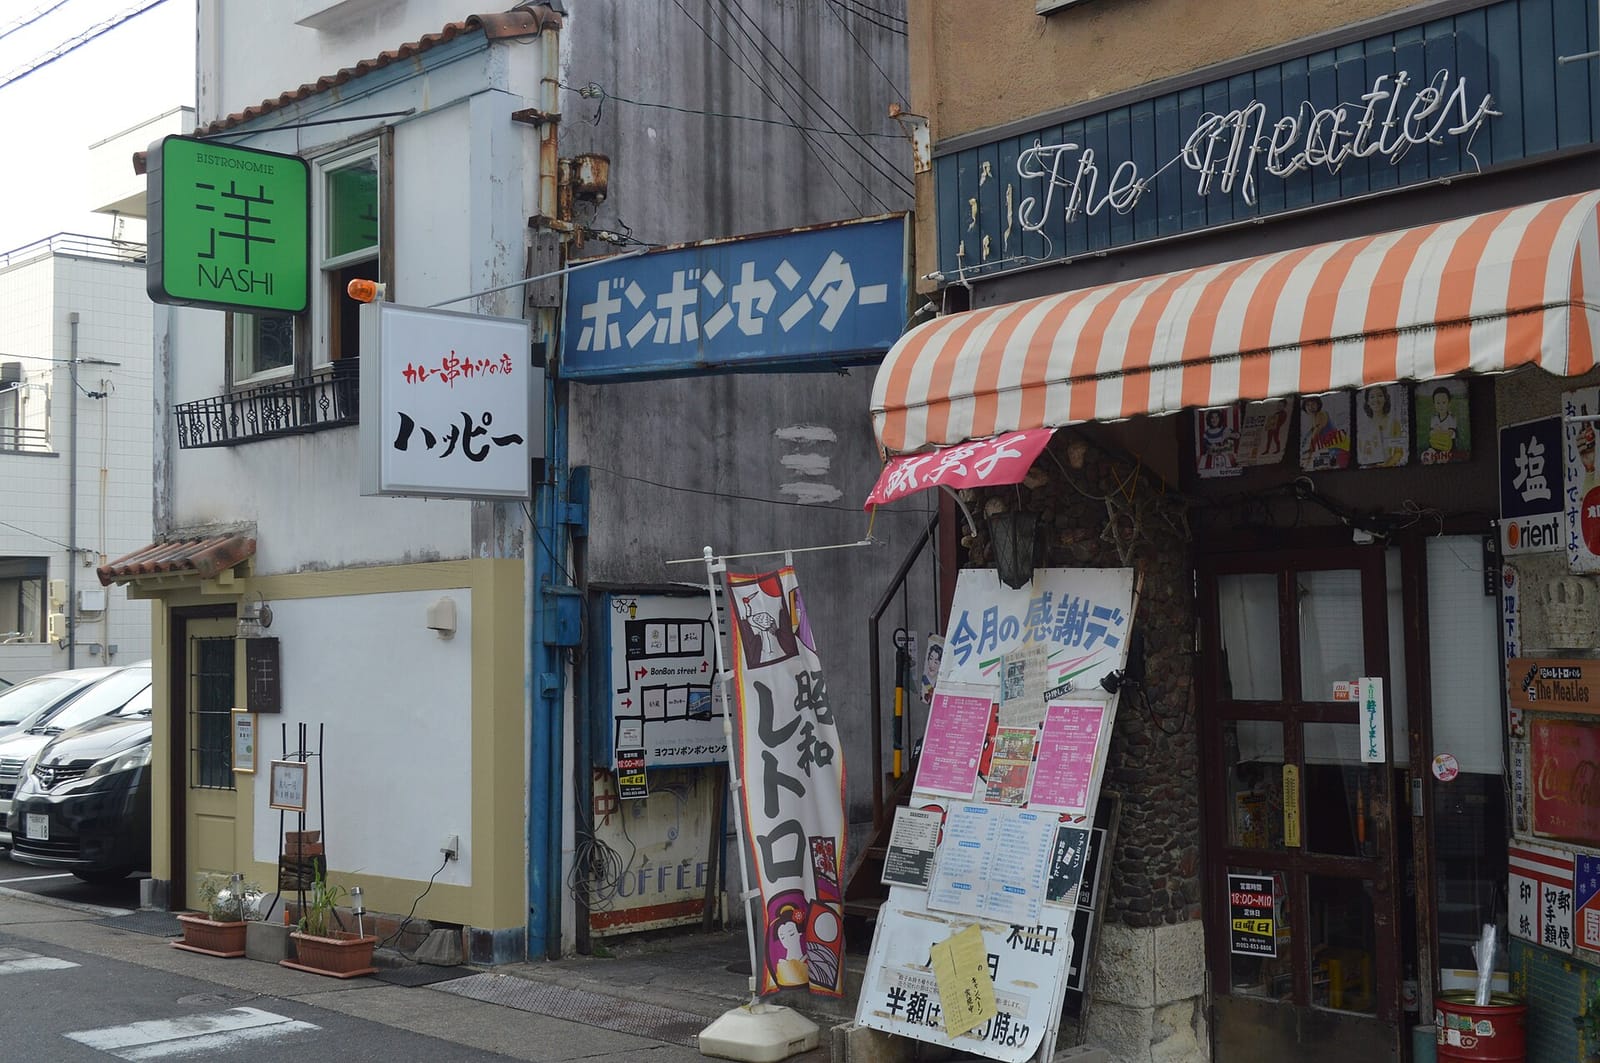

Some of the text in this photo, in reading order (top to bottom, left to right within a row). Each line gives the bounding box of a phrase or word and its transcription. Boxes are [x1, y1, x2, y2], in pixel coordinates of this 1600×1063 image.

[196, 152, 275, 175] BISTRONOMIE
[1016, 138, 1145, 231] The
[195, 180, 276, 265] 洋
[198, 263, 273, 296] NASHI
[576, 250, 889, 352] ボンボンセンター
[402, 350, 513, 389] カレー串カツの店
[394, 411, 524, 462] ハッピー
[1512, 435, 1551, 503] 塩
[950, 590, 1125, 667] 今月の感謝デー
[650, 666, 697, 676] BonBon street
[1535, 679, 1589, 703] The Meatles
[793, 670, 836, 778] 昭和
[754, 679, 807, 884] レトロ
[1234, 920, 1270, 933] 日曜日
[1519, 880, 1532, 937] 印紙
[1544, 887, 1558, 946] 切手類
[1557, 890, 1571, 950] 郵便
[886, 986, 941, 1028] 半額は
